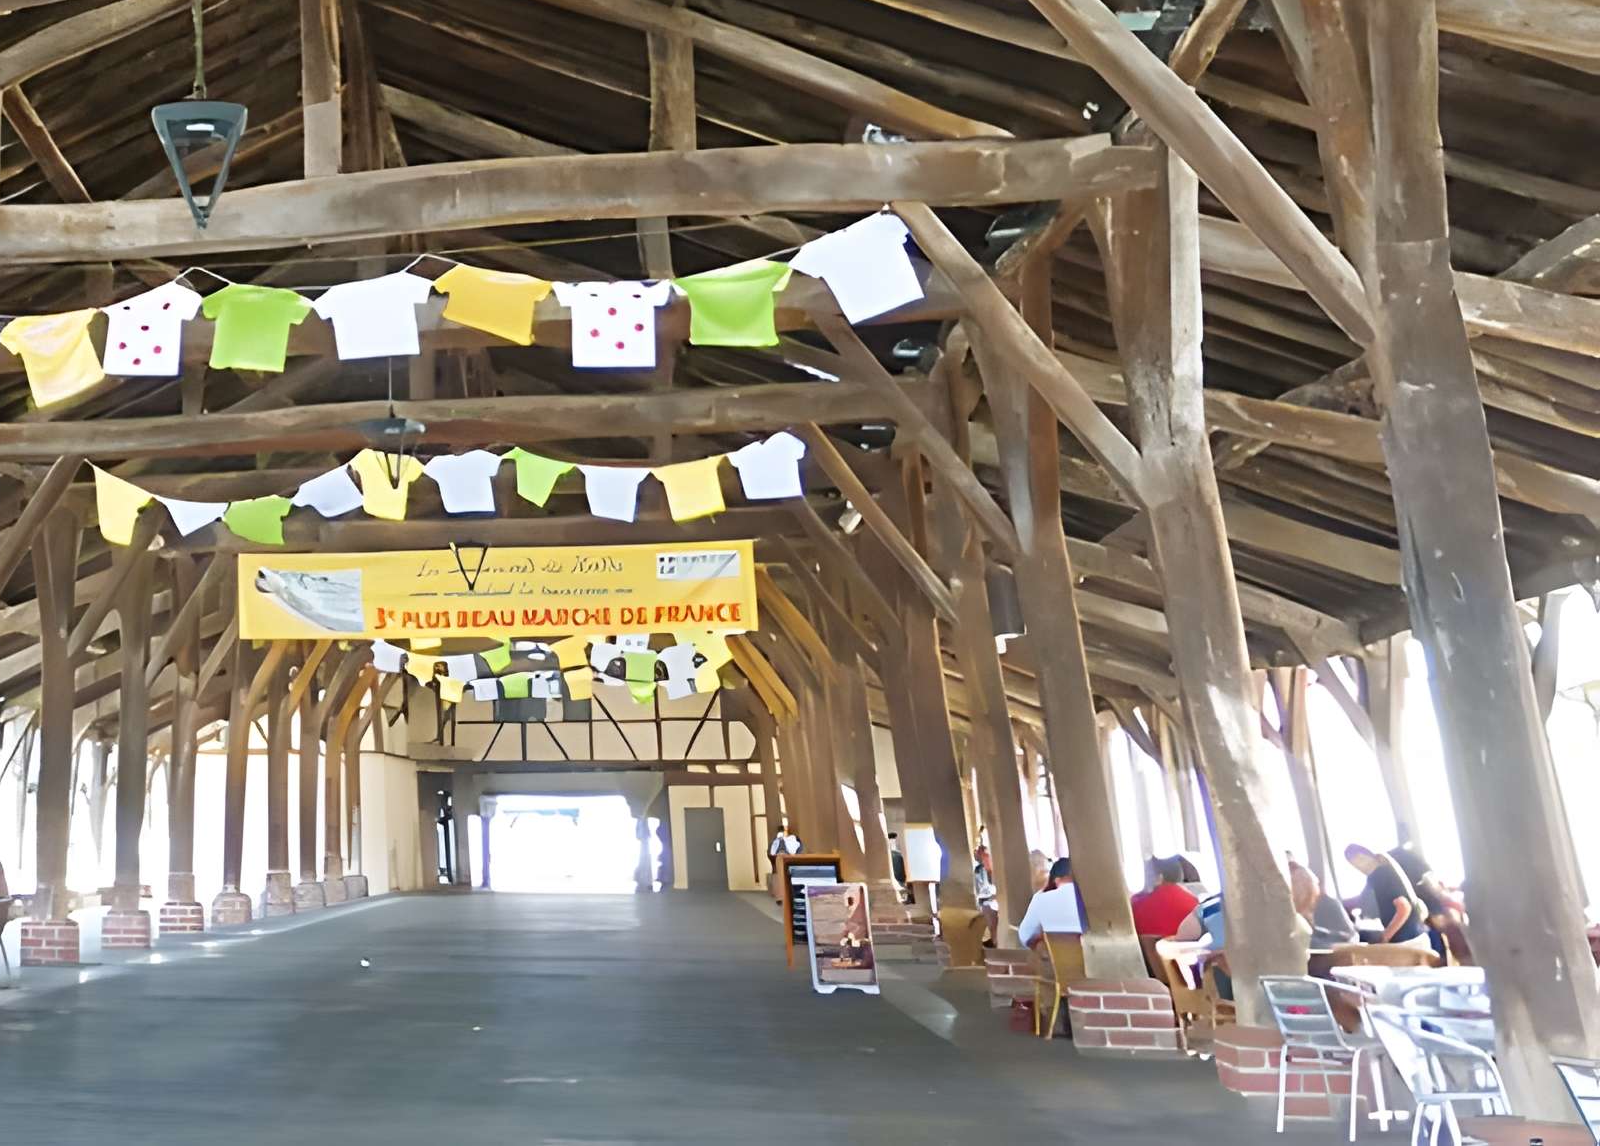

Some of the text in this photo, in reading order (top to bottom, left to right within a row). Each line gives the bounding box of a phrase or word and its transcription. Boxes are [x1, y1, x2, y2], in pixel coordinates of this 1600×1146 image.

[402, 610, 451, 629] PLUS
[456, 609, 515, 628] BEAU
[620, 606, 648, 625] DE
[654, 602, 742, 623] FRANCE
